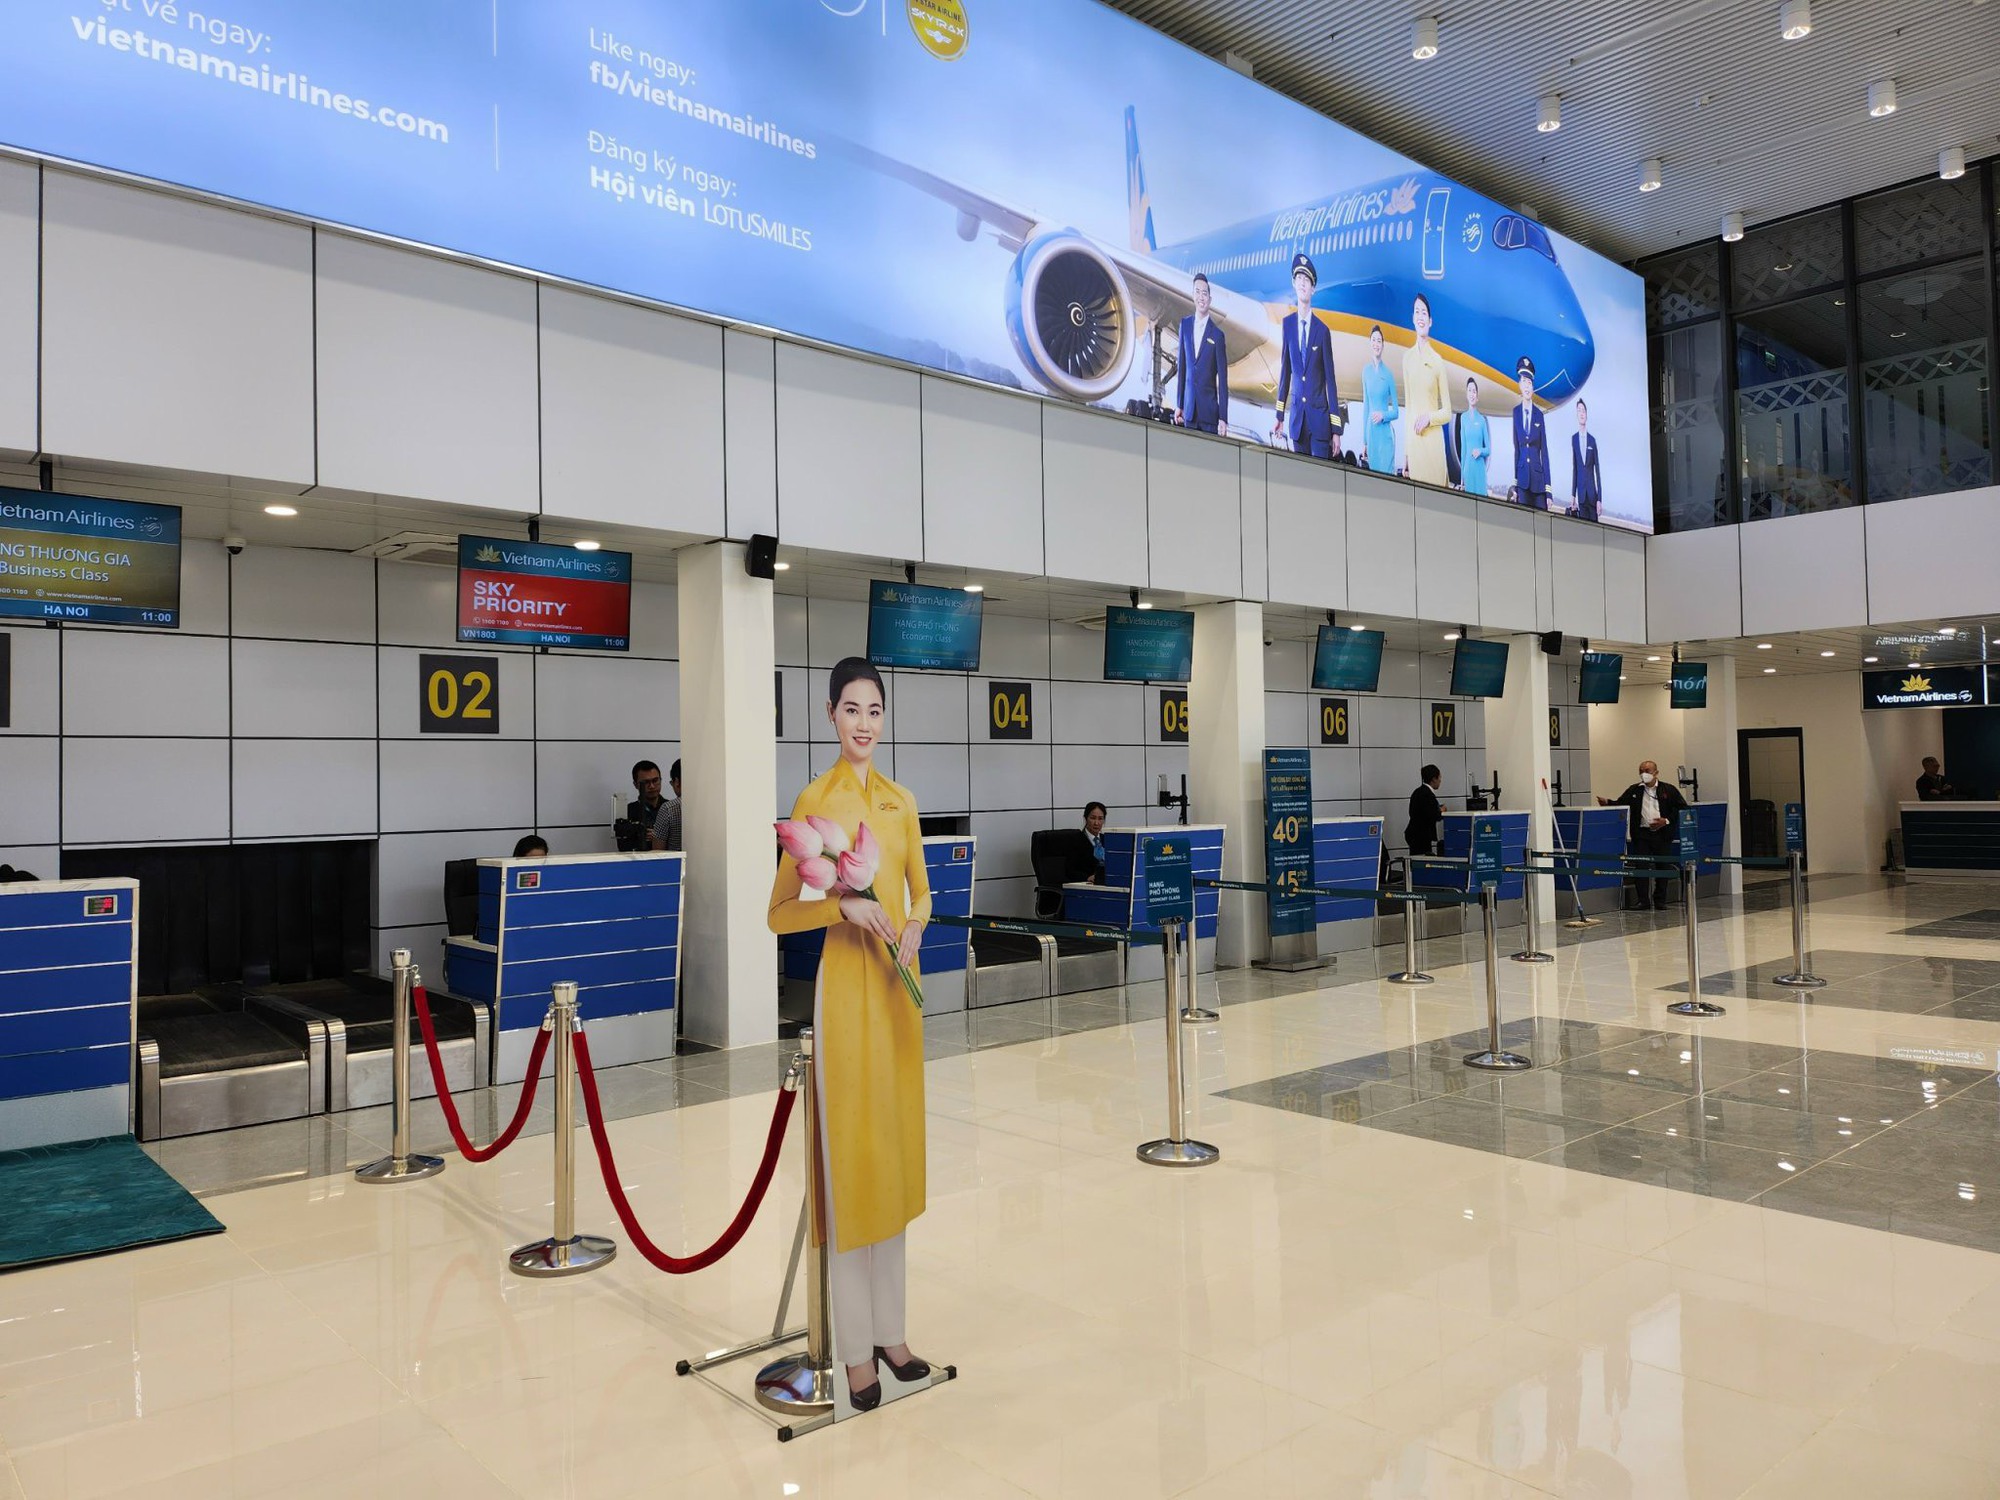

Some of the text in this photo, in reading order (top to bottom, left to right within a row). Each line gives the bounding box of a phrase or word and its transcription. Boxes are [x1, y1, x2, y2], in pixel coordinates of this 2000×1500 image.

[188, 11, 271, 54] ngay:
[910, 7, 964, 37] SKYTRAX
[590, 27, 696, 86] Like ngay:
[71, 15, 449, 143] vietnamairlines.com
[589, 60, 816, 159] fb/vietnamairlines
[587, 130, 737, 197] Đăng ký ngay:
[590, 165, 812, 251] Hội viên LOTUSMILES
[0, 502, 135, 530] ietnam Airlines
[0, 543, 131, 567] NG THƯƠNG GIA
[502, 551, 601, 573] Vietnam Airlines
[0, 560, 110, 582] Business Class
[473, 580, 515, 597] SKY
[44, 605, 171, 623] HA NOI 11:00
[473, 597, 567, 616] PRIORITY
[463, 630, 625, 646] VN1803 HA NOI 11:00
[428, 670, 492, 719] 02
[1876, 692, 1957, 704] Vietnam Airlines
[993, 692, 1029, 729] 04
[1163, 699, 1188, 733] 05
[1323, 706, 1346, 736] 06
[1434, 711, 1453, 737] 07
[1550, 714, 1559, 739] 8
[1272, 815, 1299, 844] 40
